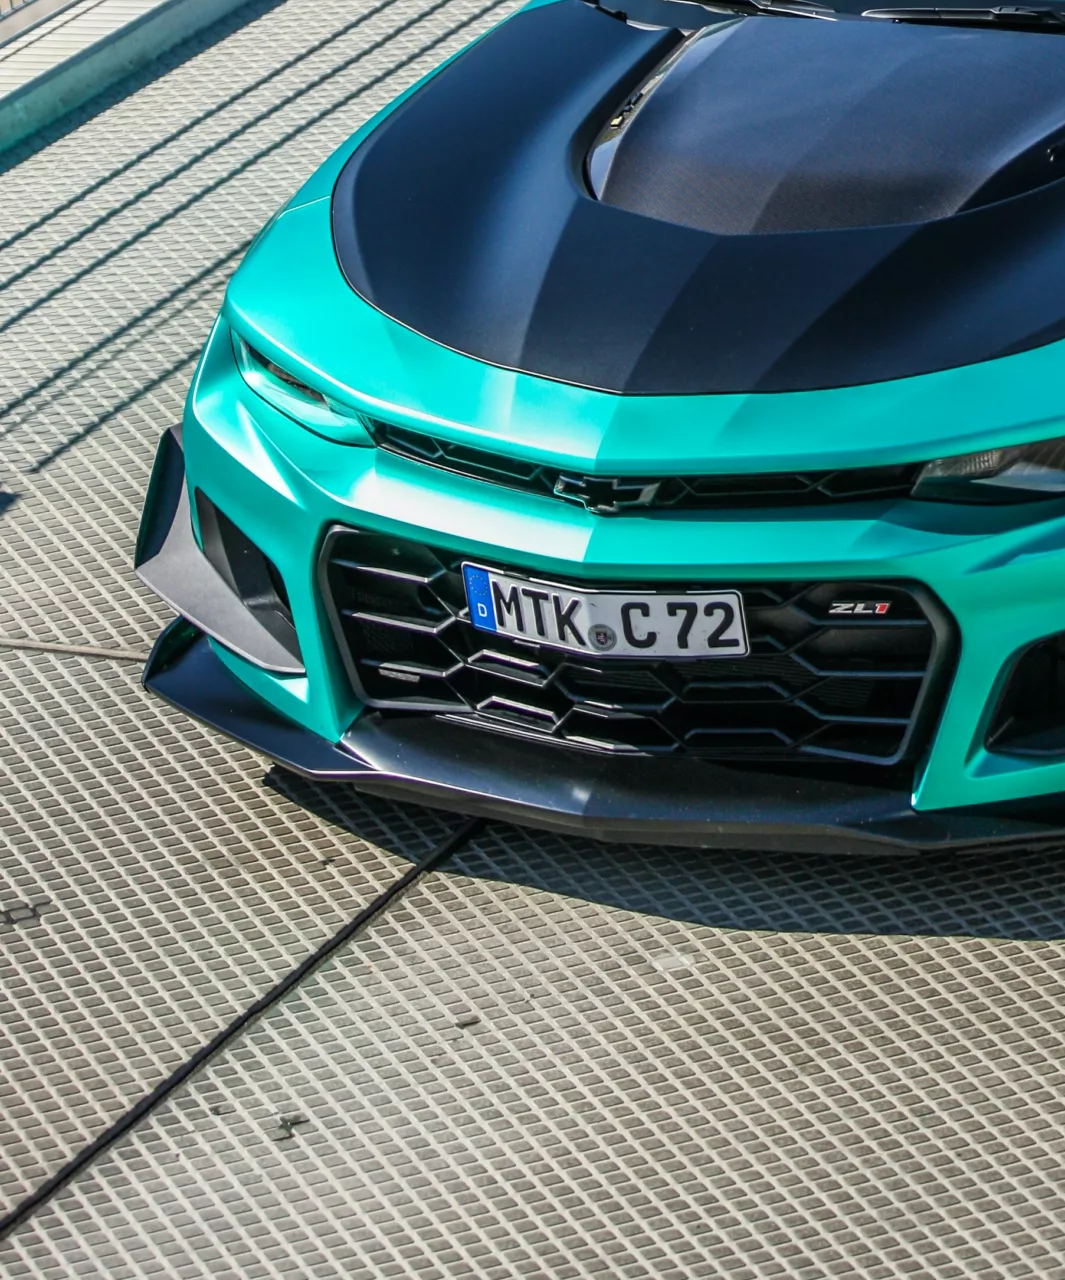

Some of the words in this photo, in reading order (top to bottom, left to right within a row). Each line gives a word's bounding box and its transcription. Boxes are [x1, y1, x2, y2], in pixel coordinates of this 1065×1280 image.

[477, 602, 488, 618] D
[491, 581, 588, 646] MTK
[620, 602, 657, 649] C
[666, 602, 740, 649] 72
[829, 603, 889, 614] ZL1
